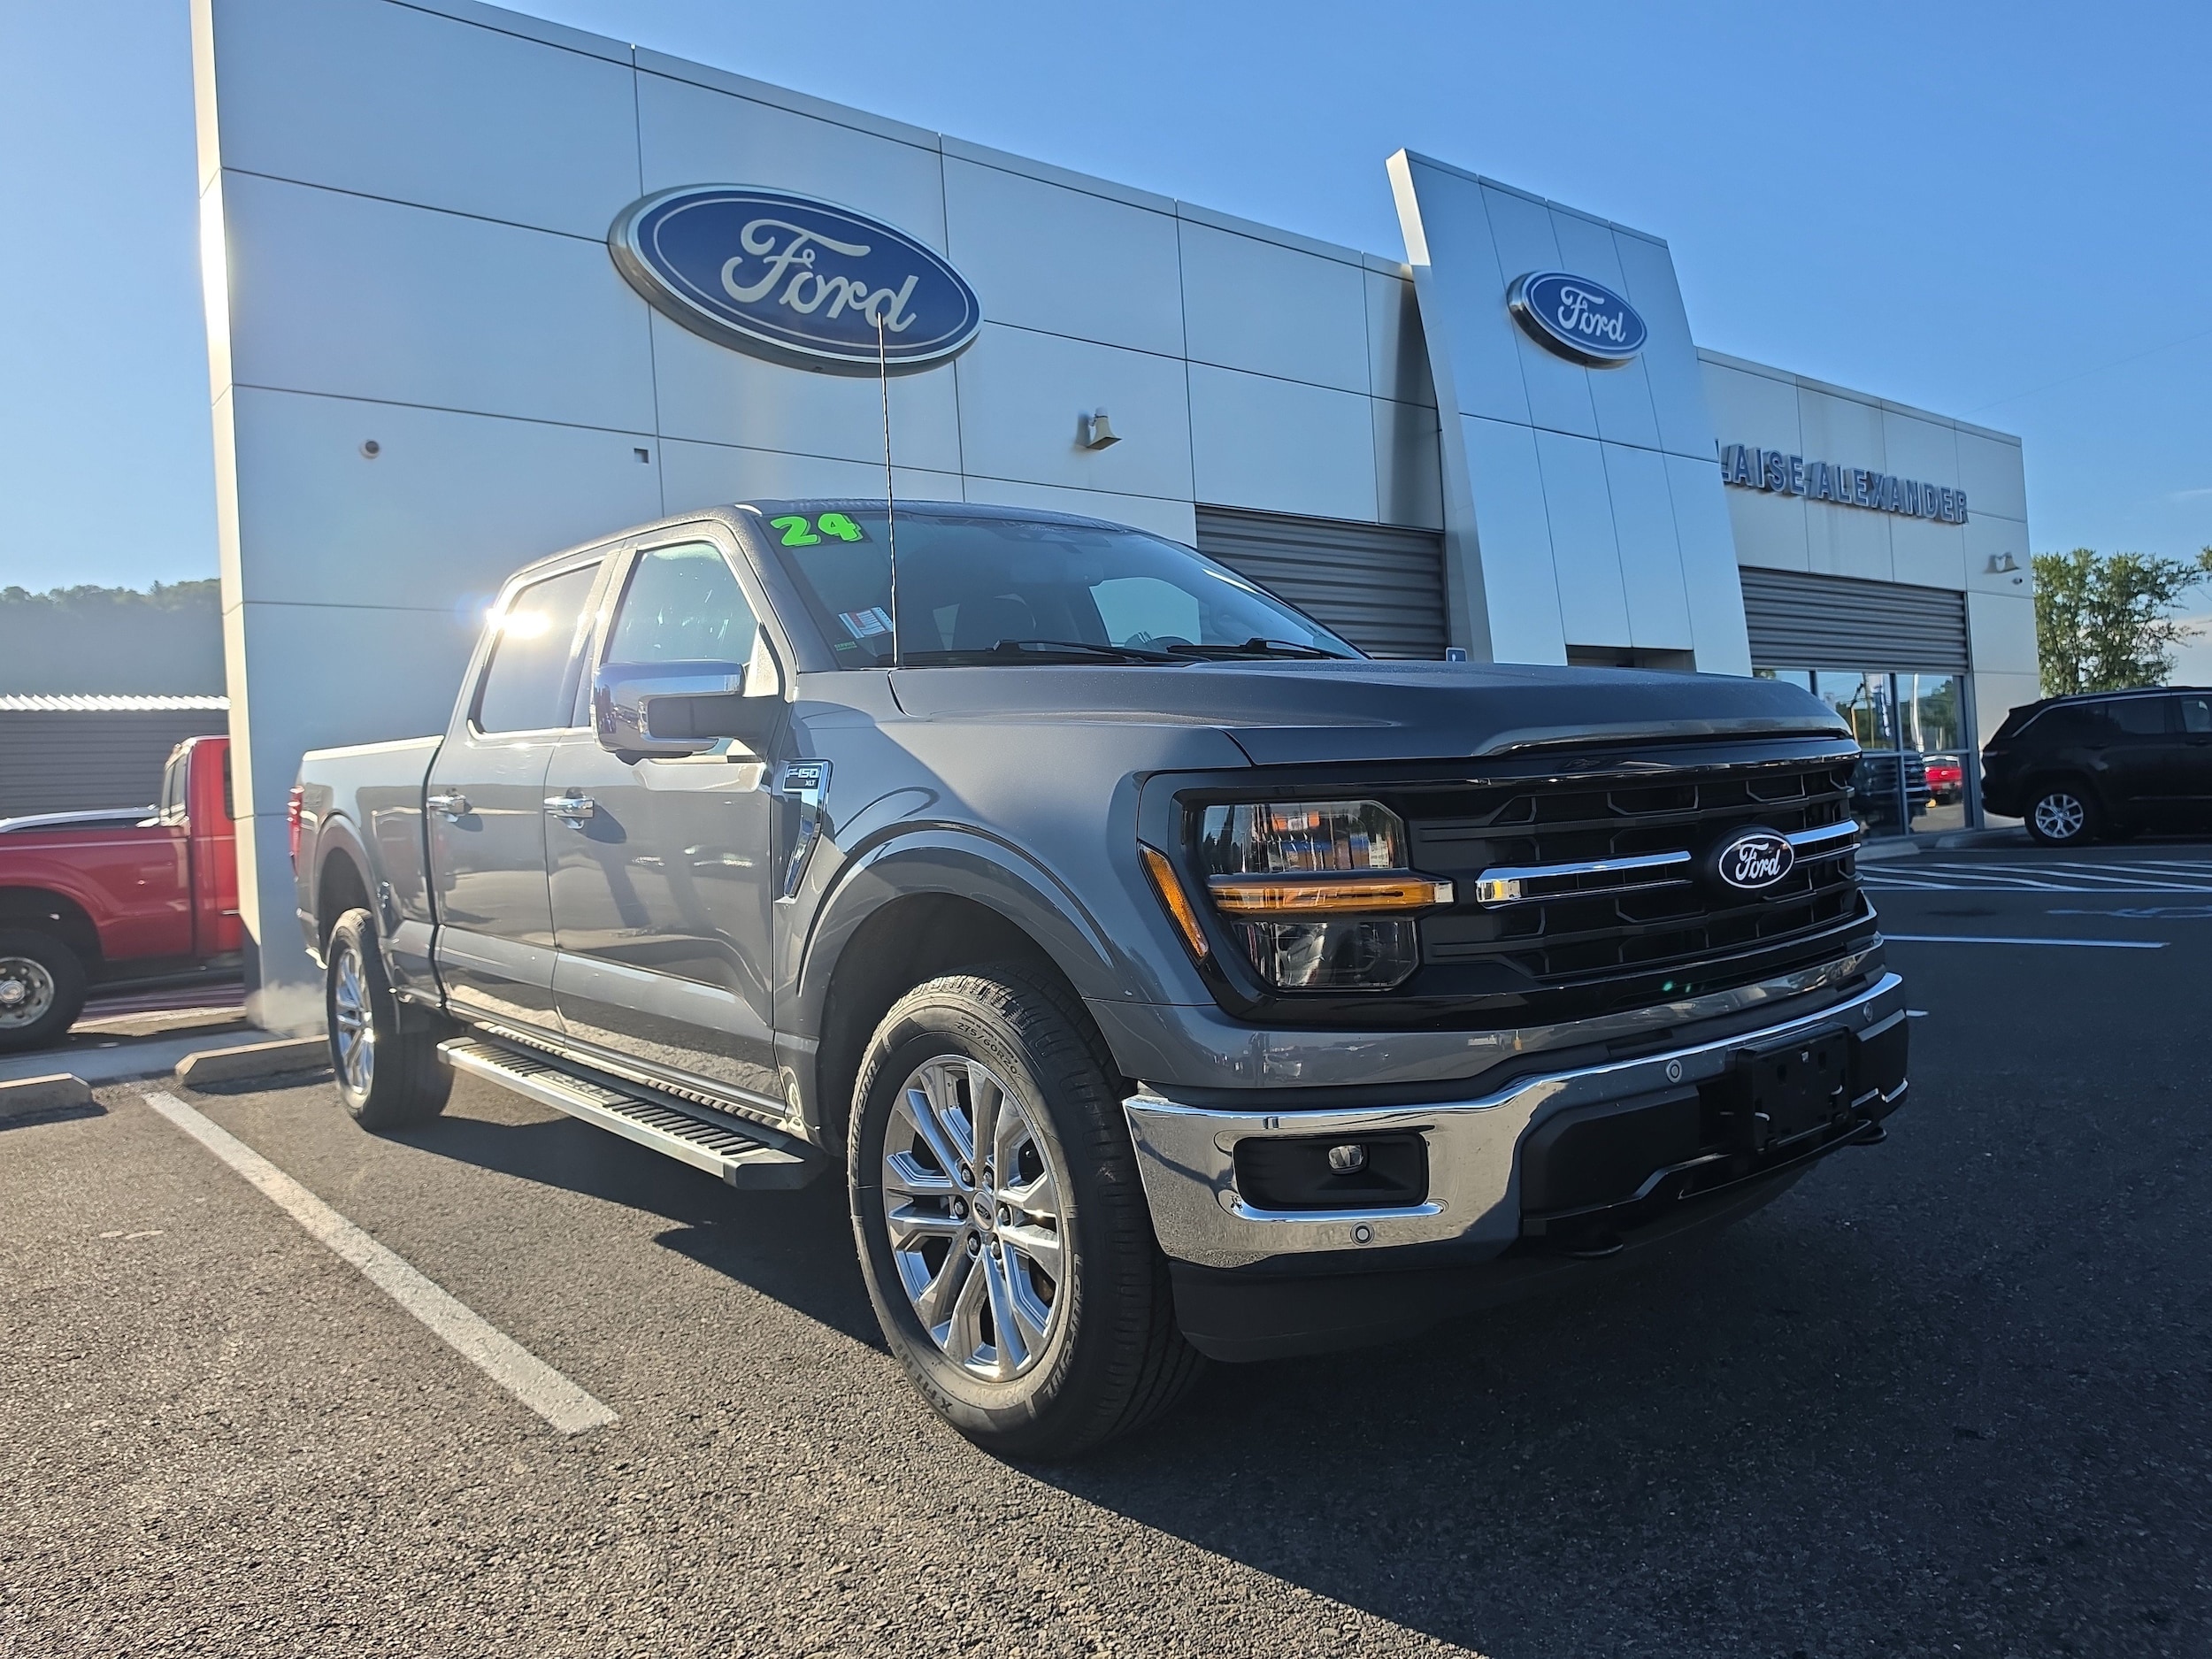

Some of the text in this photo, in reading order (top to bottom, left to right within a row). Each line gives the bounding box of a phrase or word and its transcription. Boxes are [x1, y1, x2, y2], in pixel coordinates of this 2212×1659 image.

[721, 219, 918, 332] Ford
[1558, 286, 1625, 342] Ford
[1811, 461, 1969, 524] ALEXANDER
[770, 512, 864, 546] 24
[787, 768, 819, 779] F-150
[1735, 842, 1781, 881] Ford
[956, 1021, 1018, 1075] 275/60R20
